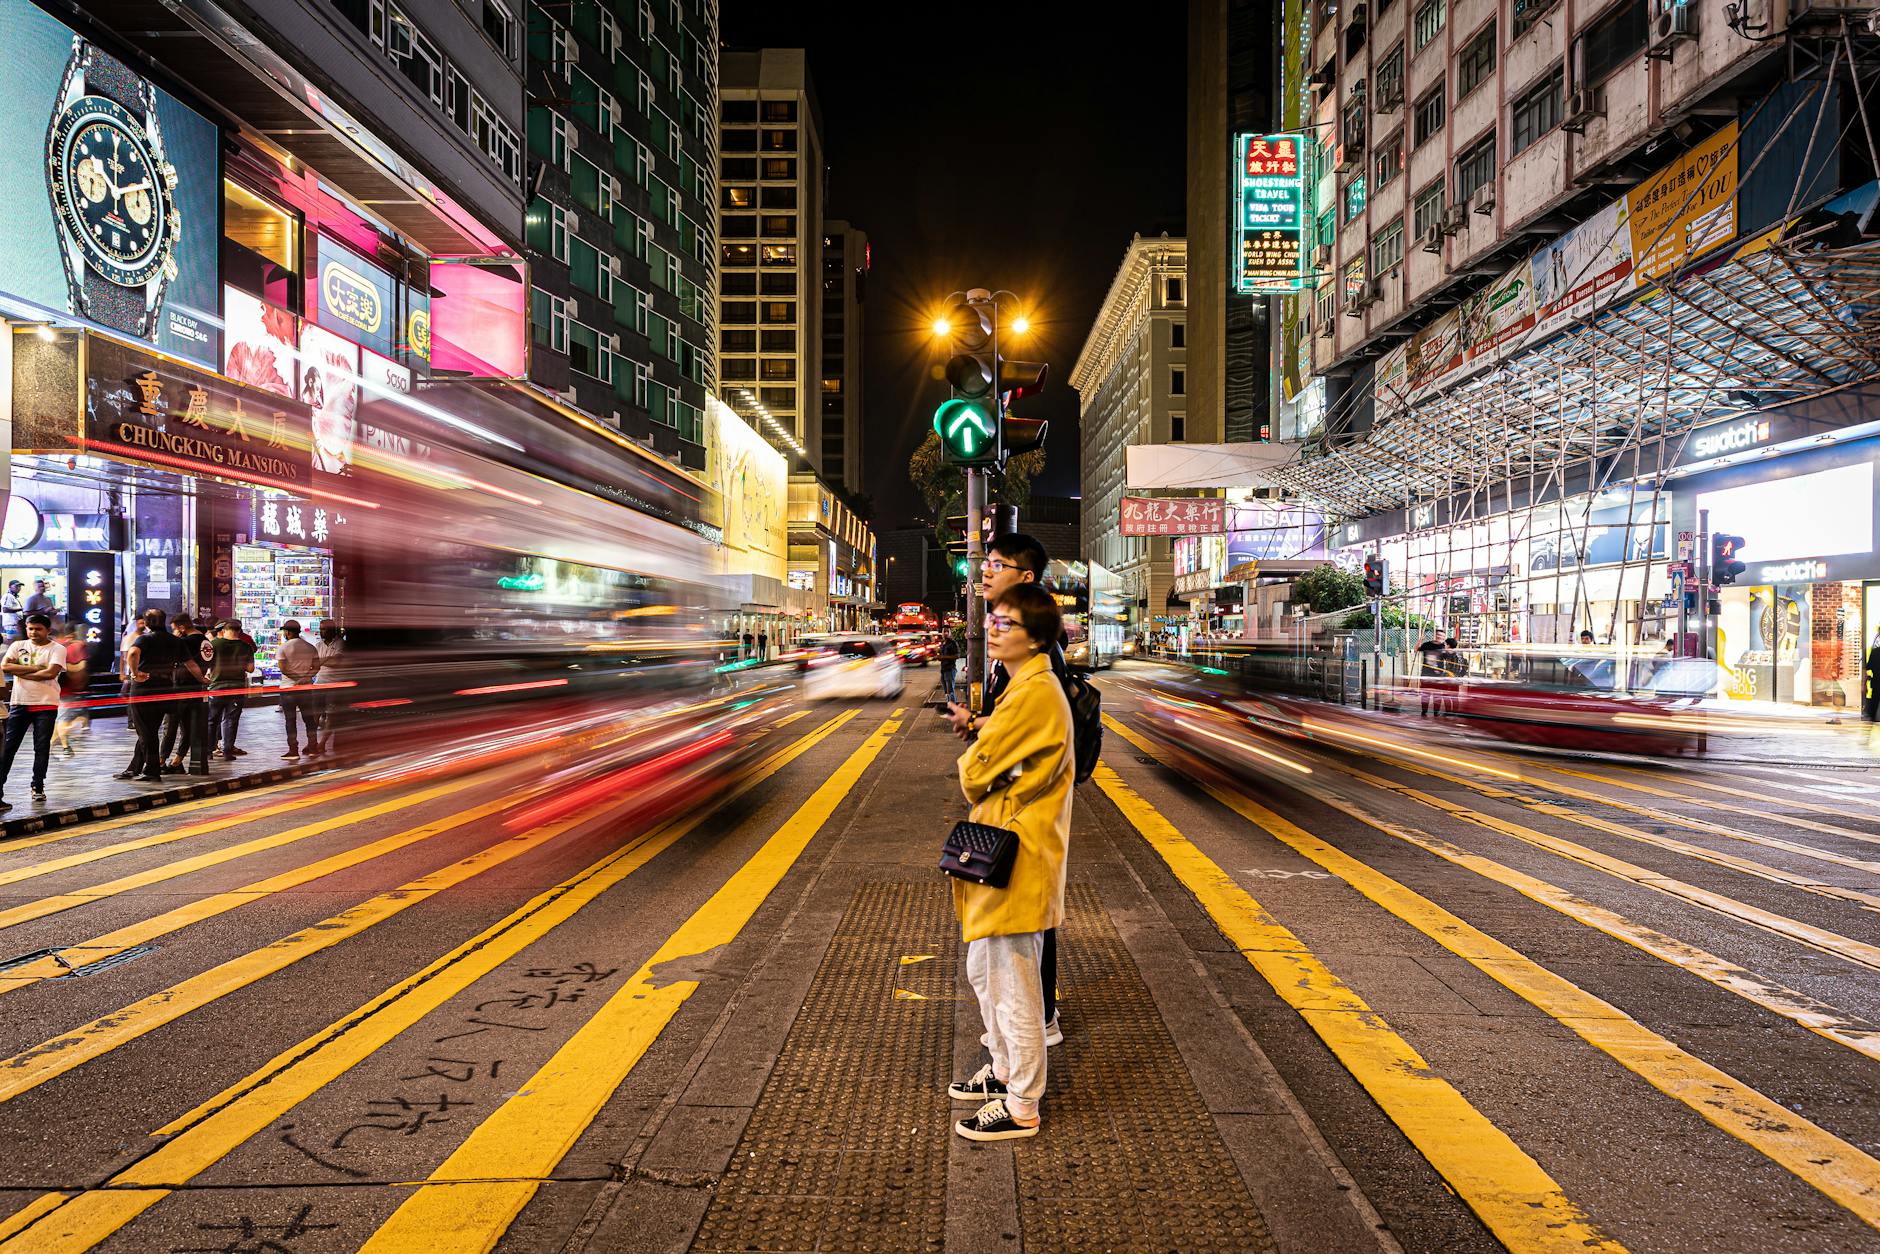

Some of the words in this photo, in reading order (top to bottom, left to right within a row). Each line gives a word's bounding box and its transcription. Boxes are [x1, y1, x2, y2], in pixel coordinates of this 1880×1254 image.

[1249, 140, 1296, 158] 天星
[1249, 160, 1297, 173] 旅行社
[1243, 177, 1301, 188] SHOESTRING
[1255, 189, 1290, 199] TRAVEL
[1272, 203, 1295, 212] TOUR
[1249, 214, 1280, 223] TICKET
[1262, 230, 1282, 239] 世界
[1248, 258, 1264, 266] KUEN
[1266, 258, 1276, 266] DO
[170, 312, 188, 326] BLACK
[187, 318, 198, 330] BAY
[1695, 420, 1759, 457] swatch
[120, 422, 224, 463] CHUNGKING
[227, 449, 297, 480] MANSIONS
[1257, 509, 1293, 527] ISA
[1760, 561, 1817, 583] swatch
[1733, 667, 1757, 684] BIG
[1732, 683, 1757, 695] BOLD
